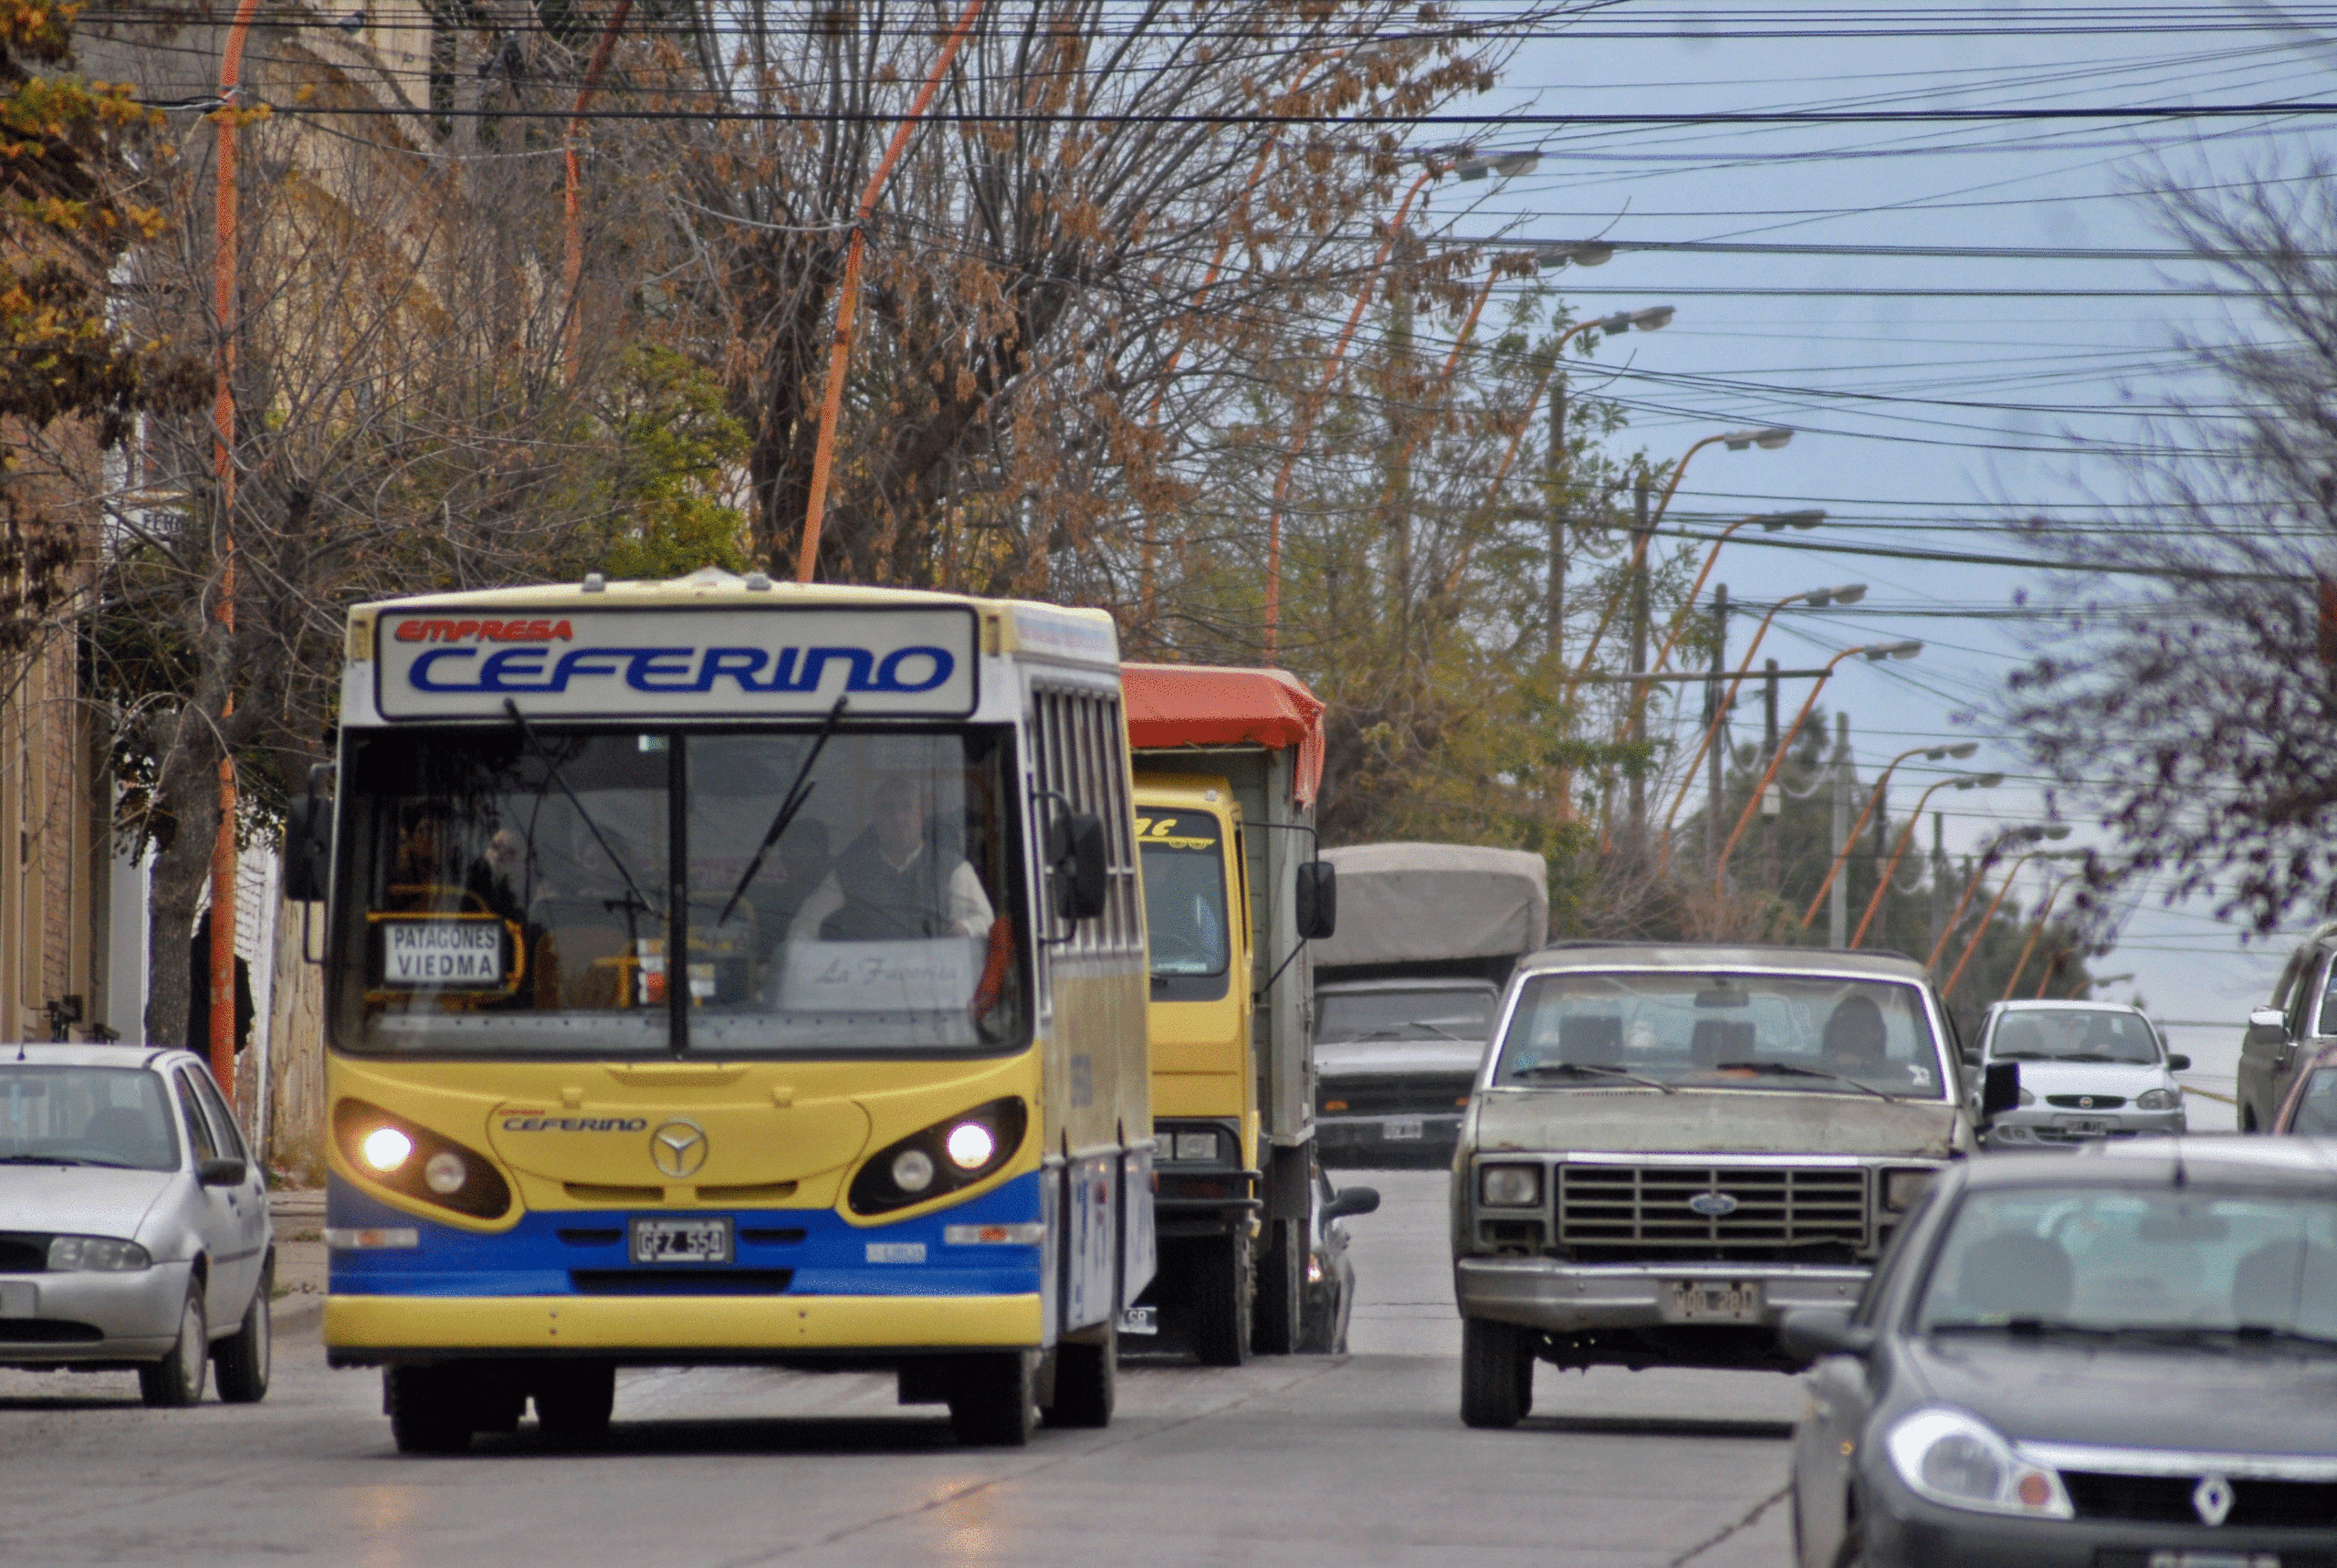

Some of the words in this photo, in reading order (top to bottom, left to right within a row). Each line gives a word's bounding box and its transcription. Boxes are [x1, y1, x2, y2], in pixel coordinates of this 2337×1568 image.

[394, 620, 573, 642] EMPRESA
[408, 645, 955, 694] CEFERINO
[395, 927, 496, 949] PATAGONES
[398, 955, 493, 976] VIEDMA
[503, 1117, 647, 1132] CEFERINO
